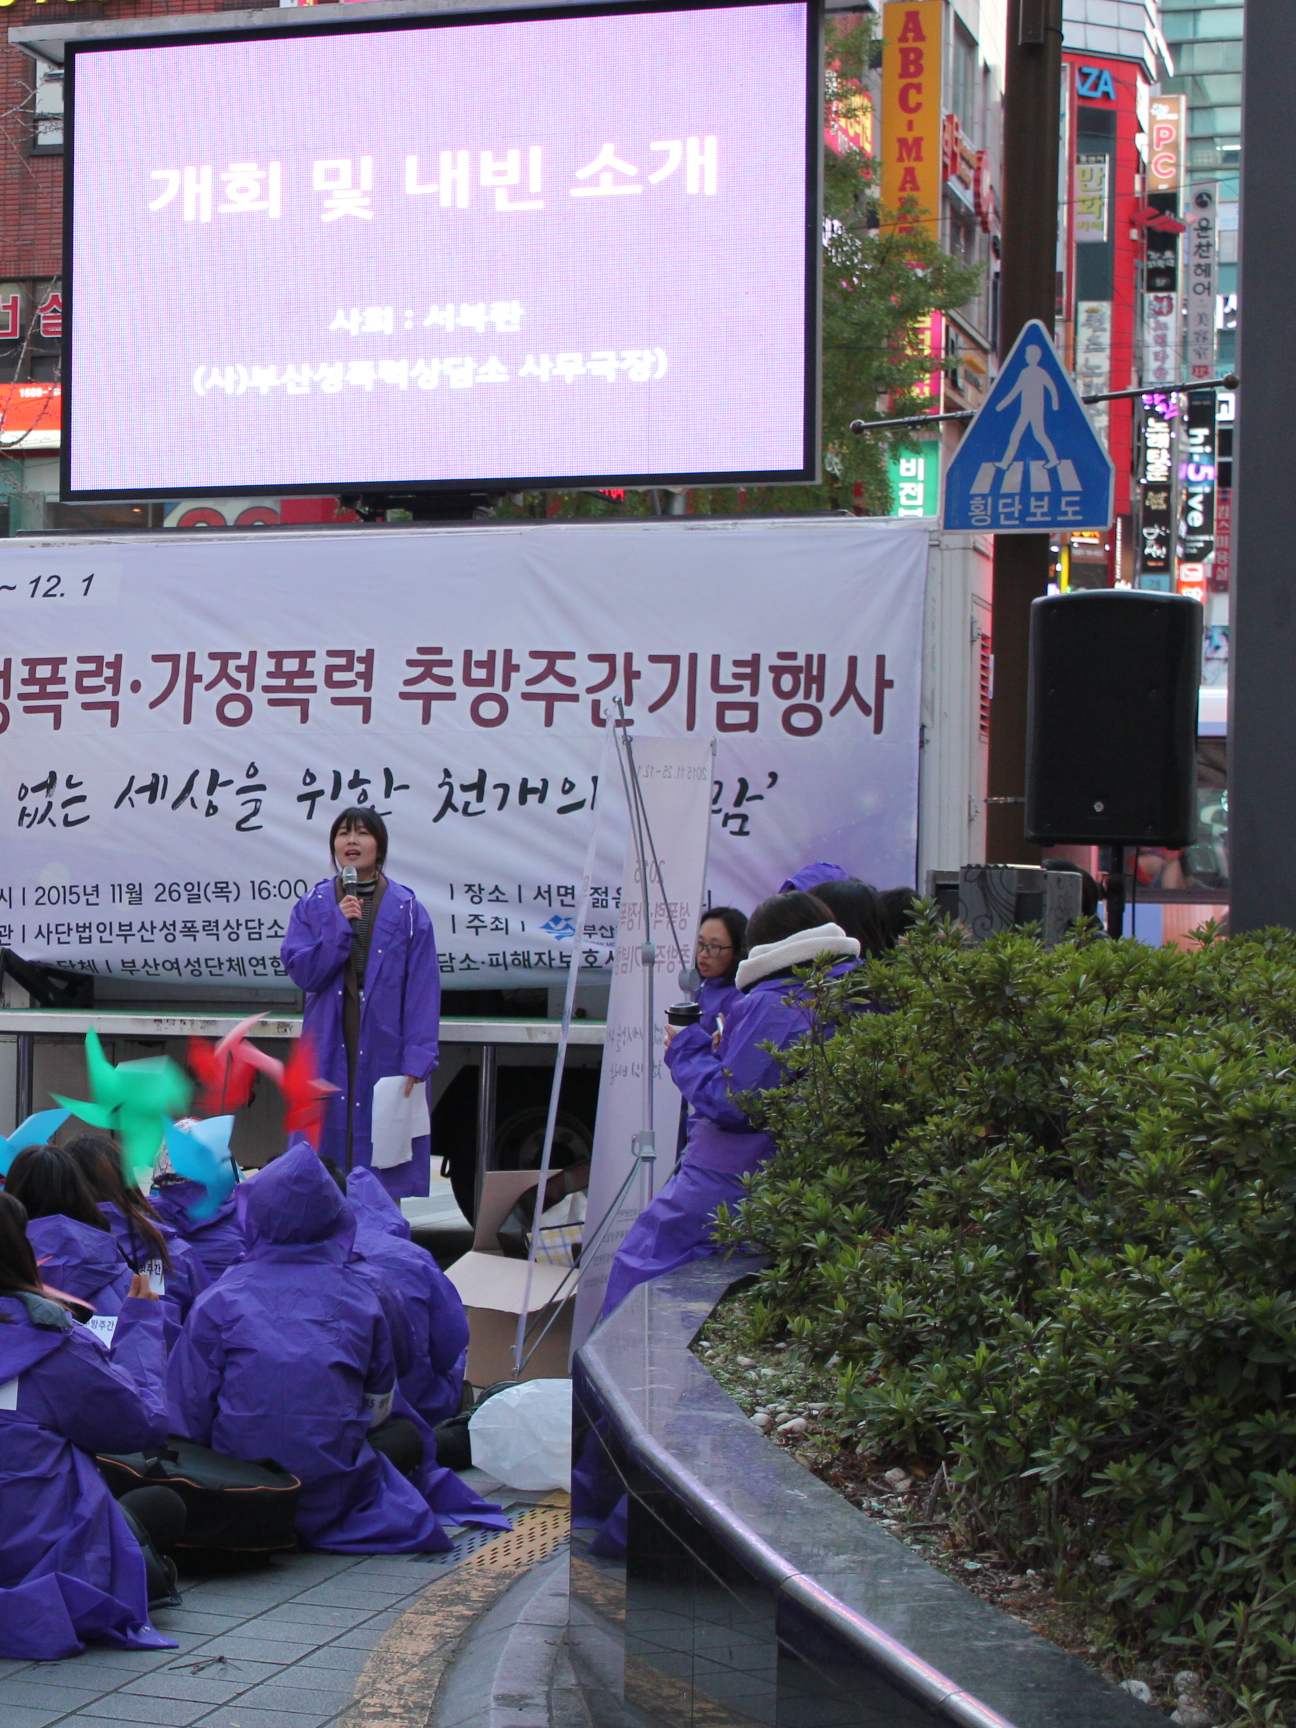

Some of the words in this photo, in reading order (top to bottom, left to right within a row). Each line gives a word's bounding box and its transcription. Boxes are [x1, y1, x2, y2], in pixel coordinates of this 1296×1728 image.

[149, 161, 282, 222] 개회
[312, 156, 375, 222] 및
[405, 145, 545, 212] 내빈
[570, 135, 718, 197] 소개
[968, 496, 1083, 526] 횡단보도
[29, 574, 65, 598] 12.
[81, 573, 95, 597] 1
[398, 646, 894, 736] 추방주간기념행사
[18, 770, 90, 830] 없는
[114, 761, 268, 832] 세상을
[432, 768, 598, 823] 천개의
[34, 884, 100, 907] 2015년
[111, 882, 142, 906] 11월
[154, 880, 241, 903] 26일(목)
[250, 879, 307, 901] 16:00
[464, 883, 509, 905] 장소
[533, 885, 576, 908] 서면
[34, 918, 285, 945] 사단법인부산성폭력상담소
[466, 914, 509, 936] 주최
